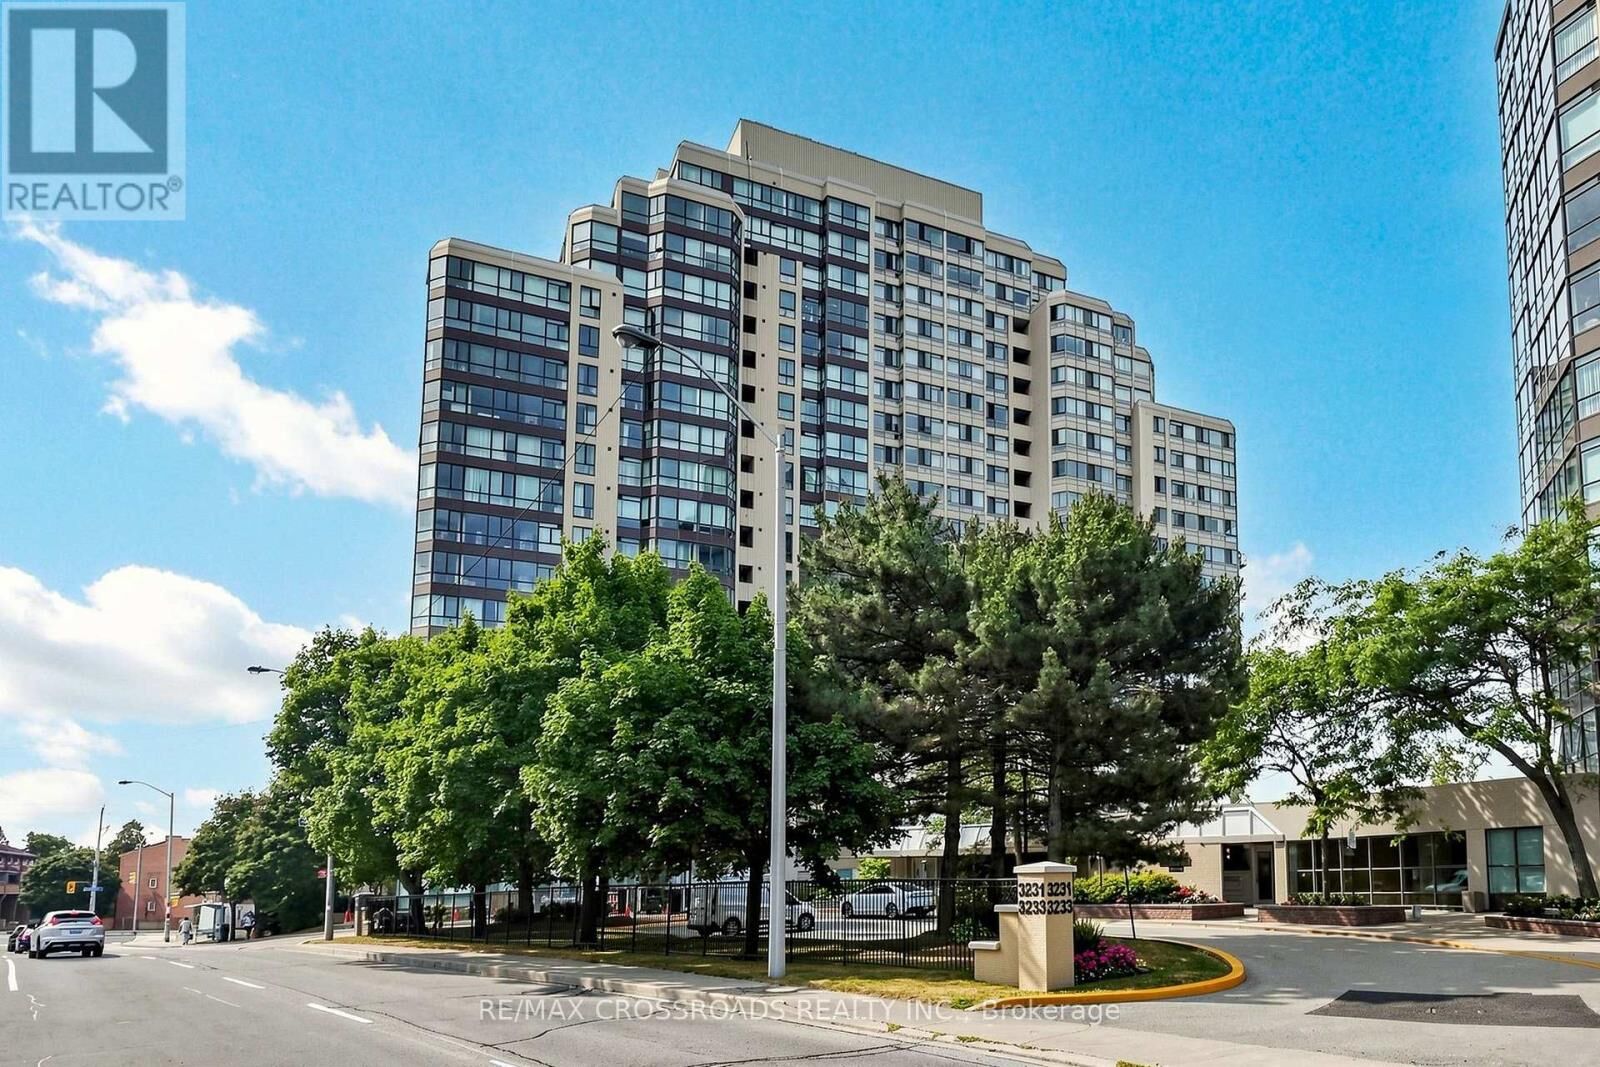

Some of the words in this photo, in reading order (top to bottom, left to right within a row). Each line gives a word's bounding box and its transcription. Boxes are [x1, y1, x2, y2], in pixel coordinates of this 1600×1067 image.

[1018, 883, 1045, 897] 3231
[1047, 882, 1072, 897] 3231
[1018, 901, 1046, 915] 3233
[1047, 900, 1073, 915] 3233
